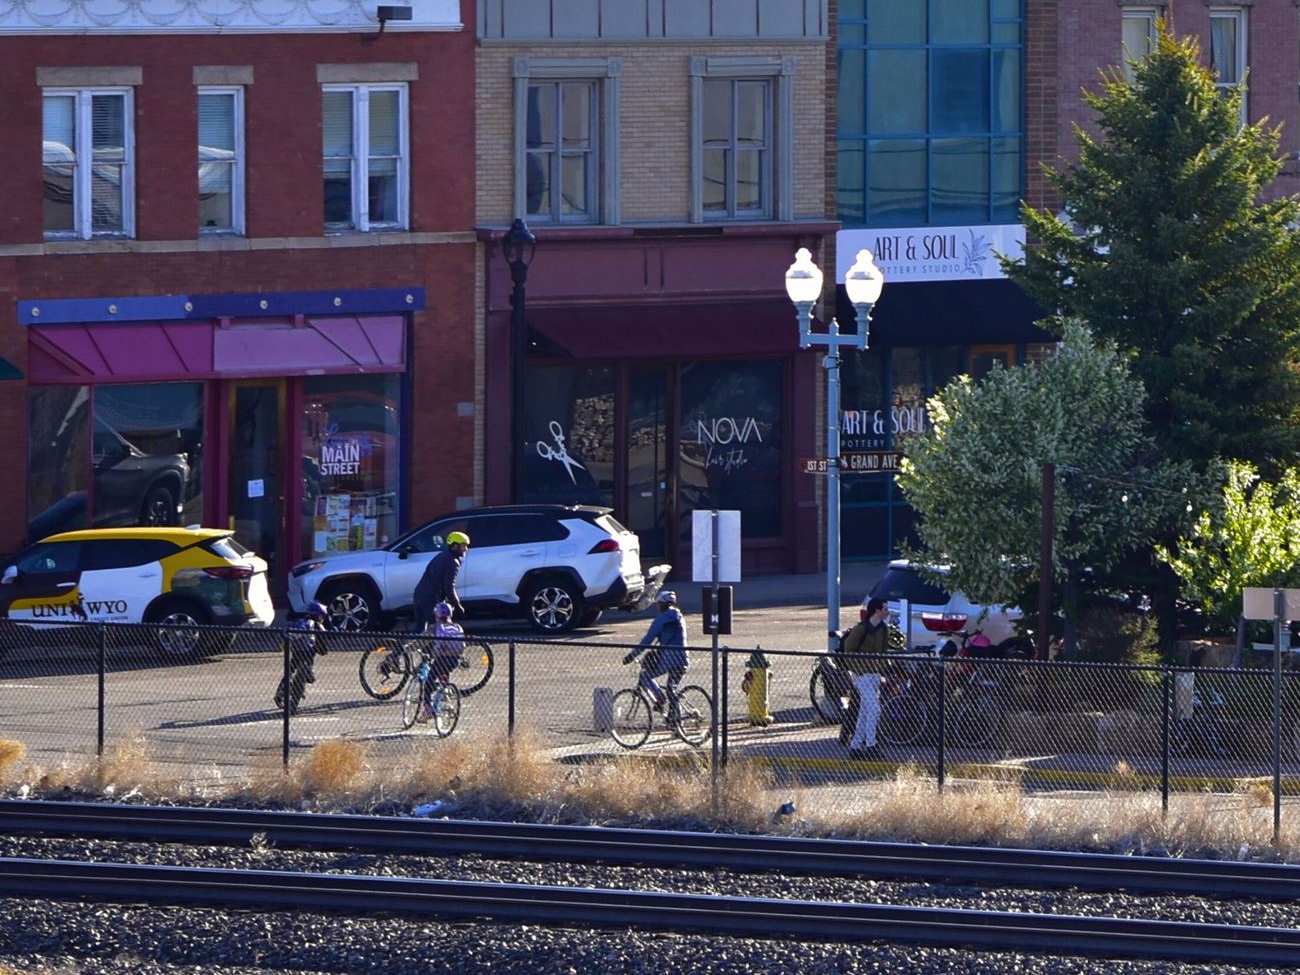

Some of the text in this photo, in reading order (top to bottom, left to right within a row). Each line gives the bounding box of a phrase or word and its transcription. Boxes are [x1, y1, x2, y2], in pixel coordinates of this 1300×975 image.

[874, 234, 959, 262] ART & SOUL
[880, 264, 961, 275] OTTERY STUDIO
[698, 416, 762, 445] NOVA
[841, 407, 926, 435] ART & SOUL
[841, 439, 885, 448] POTTERY
[321, 444, 360, 463] MAIN
[850, 453, 898, 469] GRAND AVE
[321, 462, 360, 476] STREET
[31, 599, 128, 618] UNI WYO
